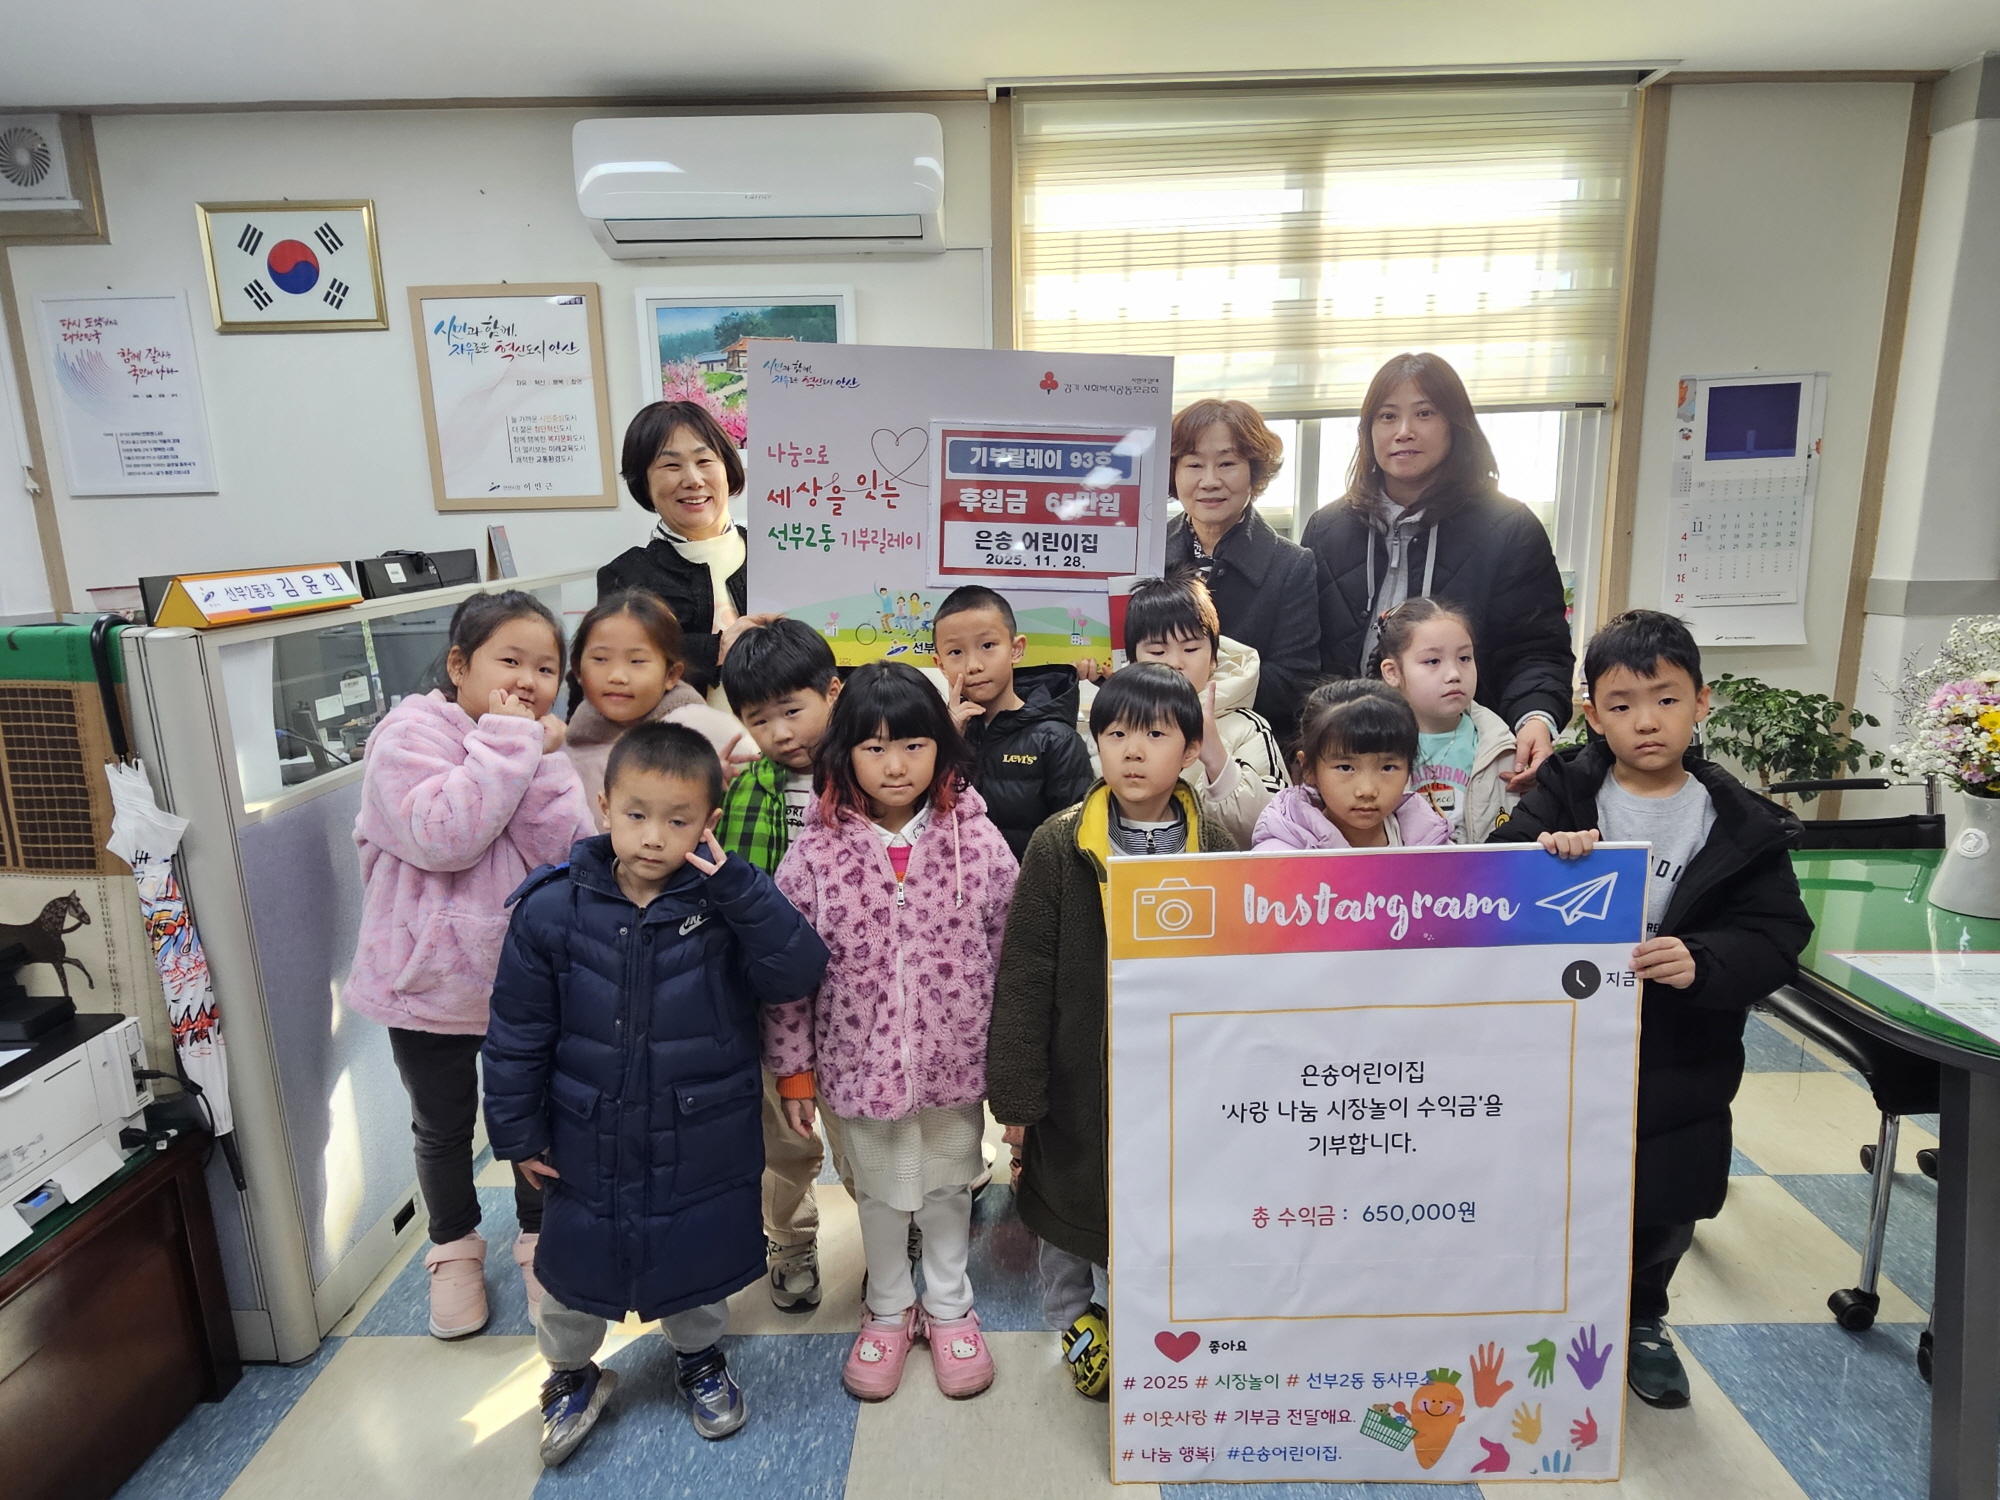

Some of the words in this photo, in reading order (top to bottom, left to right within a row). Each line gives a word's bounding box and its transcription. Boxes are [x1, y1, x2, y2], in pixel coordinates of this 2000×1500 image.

[60, 318, 80, 330] 다시
[434, 315, 482, 345] 시민과
[62, 330, 102, 345] 대한민국
[117, 348, 141, 363] 함께
[449, 342, 490, 365] 자유로운
[494, 339, 545, 362] 혁신도시
[549, 341, 580, 356] 안산
[836, 377, 860, 388] 안산
[1064, 383, 1080, 393] 경기
[1083, 384, 1159, 396] 사회복지공동모금회
[540, 414, 577, 422] 시민중심도시
[534, 425, 572, 433] 첨단혁신도시
[548, 434, 585, 442] 복지문화도시
[536, 455, 573, 463] 교통환경도시
[969, 447, 1062, 470] 기부릴레이
[767, 476, 846, 516] 세상을
[958, 487, 1028, 514] 후원금
[1692, 521, 1703, 532] 11
[768, 523, 836, 552] 선부2동
[841, 528, 921, 554] 기부릴레이
[975, 529, 1013, 551] 은송
[1022, 531, 1099, 554] 어린이집
[1681, 532, 1687, 541] 4
[985, 553, 1027, 567] 2025.
[1035, 555, 1057, 568] 11.
[1063, 555, 1086, 569] 28.
[1678, 553, 1687, 562] 11
[224, 583, 275, 601] 선부2동장
[1244, 882, 1521, 940] Instargram
[1606, 971, 1637, 988] 지금
[1300, 1061, 1425, 1087] 은송어린이집
[1221, 1101, 1269, 1124] '사랑
[1278, 1100, 1318, 1123] 나눔
[1326, 1097, 1408, 1120] 시장놀이
[1416, 1094, 1503, 1118] 수익금'을
[1308, 1132, 1417, 1157] 기부합니다.
[1251, 1206, 1270, 1229] 총
[1362, 1201, 1476, 1225] 650,000원
[1208, 1340, 1248, 1355] 좋아요
[1143, 1375, 1188, 1390] 2025
[1215, 1373, 1279, 1390] 시장놀이
[1306, 1372, 1365, 1390] 선부2동
[1142, 1409, 1208, 1427] 이웃사랑
[1234, 1409, 1281, 1426] 기부금
[1287, 1409, 1356, 1426] 전달해요.
[1141, 1447, 1172, 1463] 나눔
[1178, 1446, 1215, 1463] 행복!
